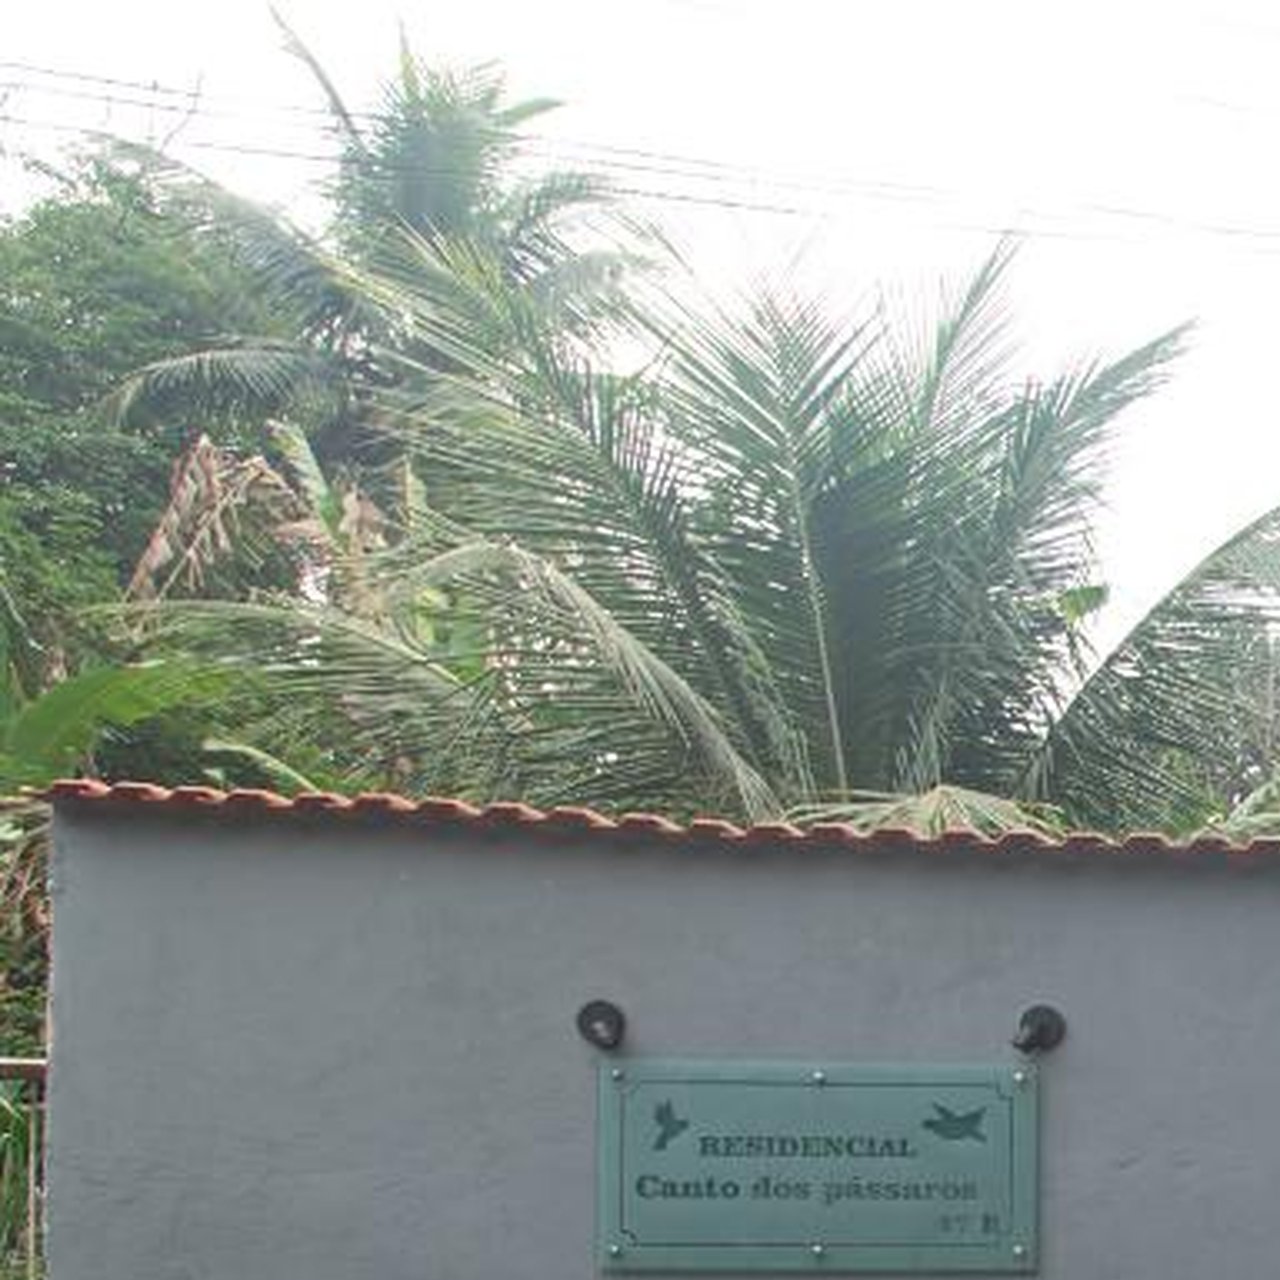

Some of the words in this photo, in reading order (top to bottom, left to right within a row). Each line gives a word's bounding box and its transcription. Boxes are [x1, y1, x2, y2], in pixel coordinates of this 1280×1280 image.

[700, 1136, 917, 1158] RESIDENCIAL
[636, 1174, 740, 1200] Canto
[752, 1176, 808, 1200] dos
